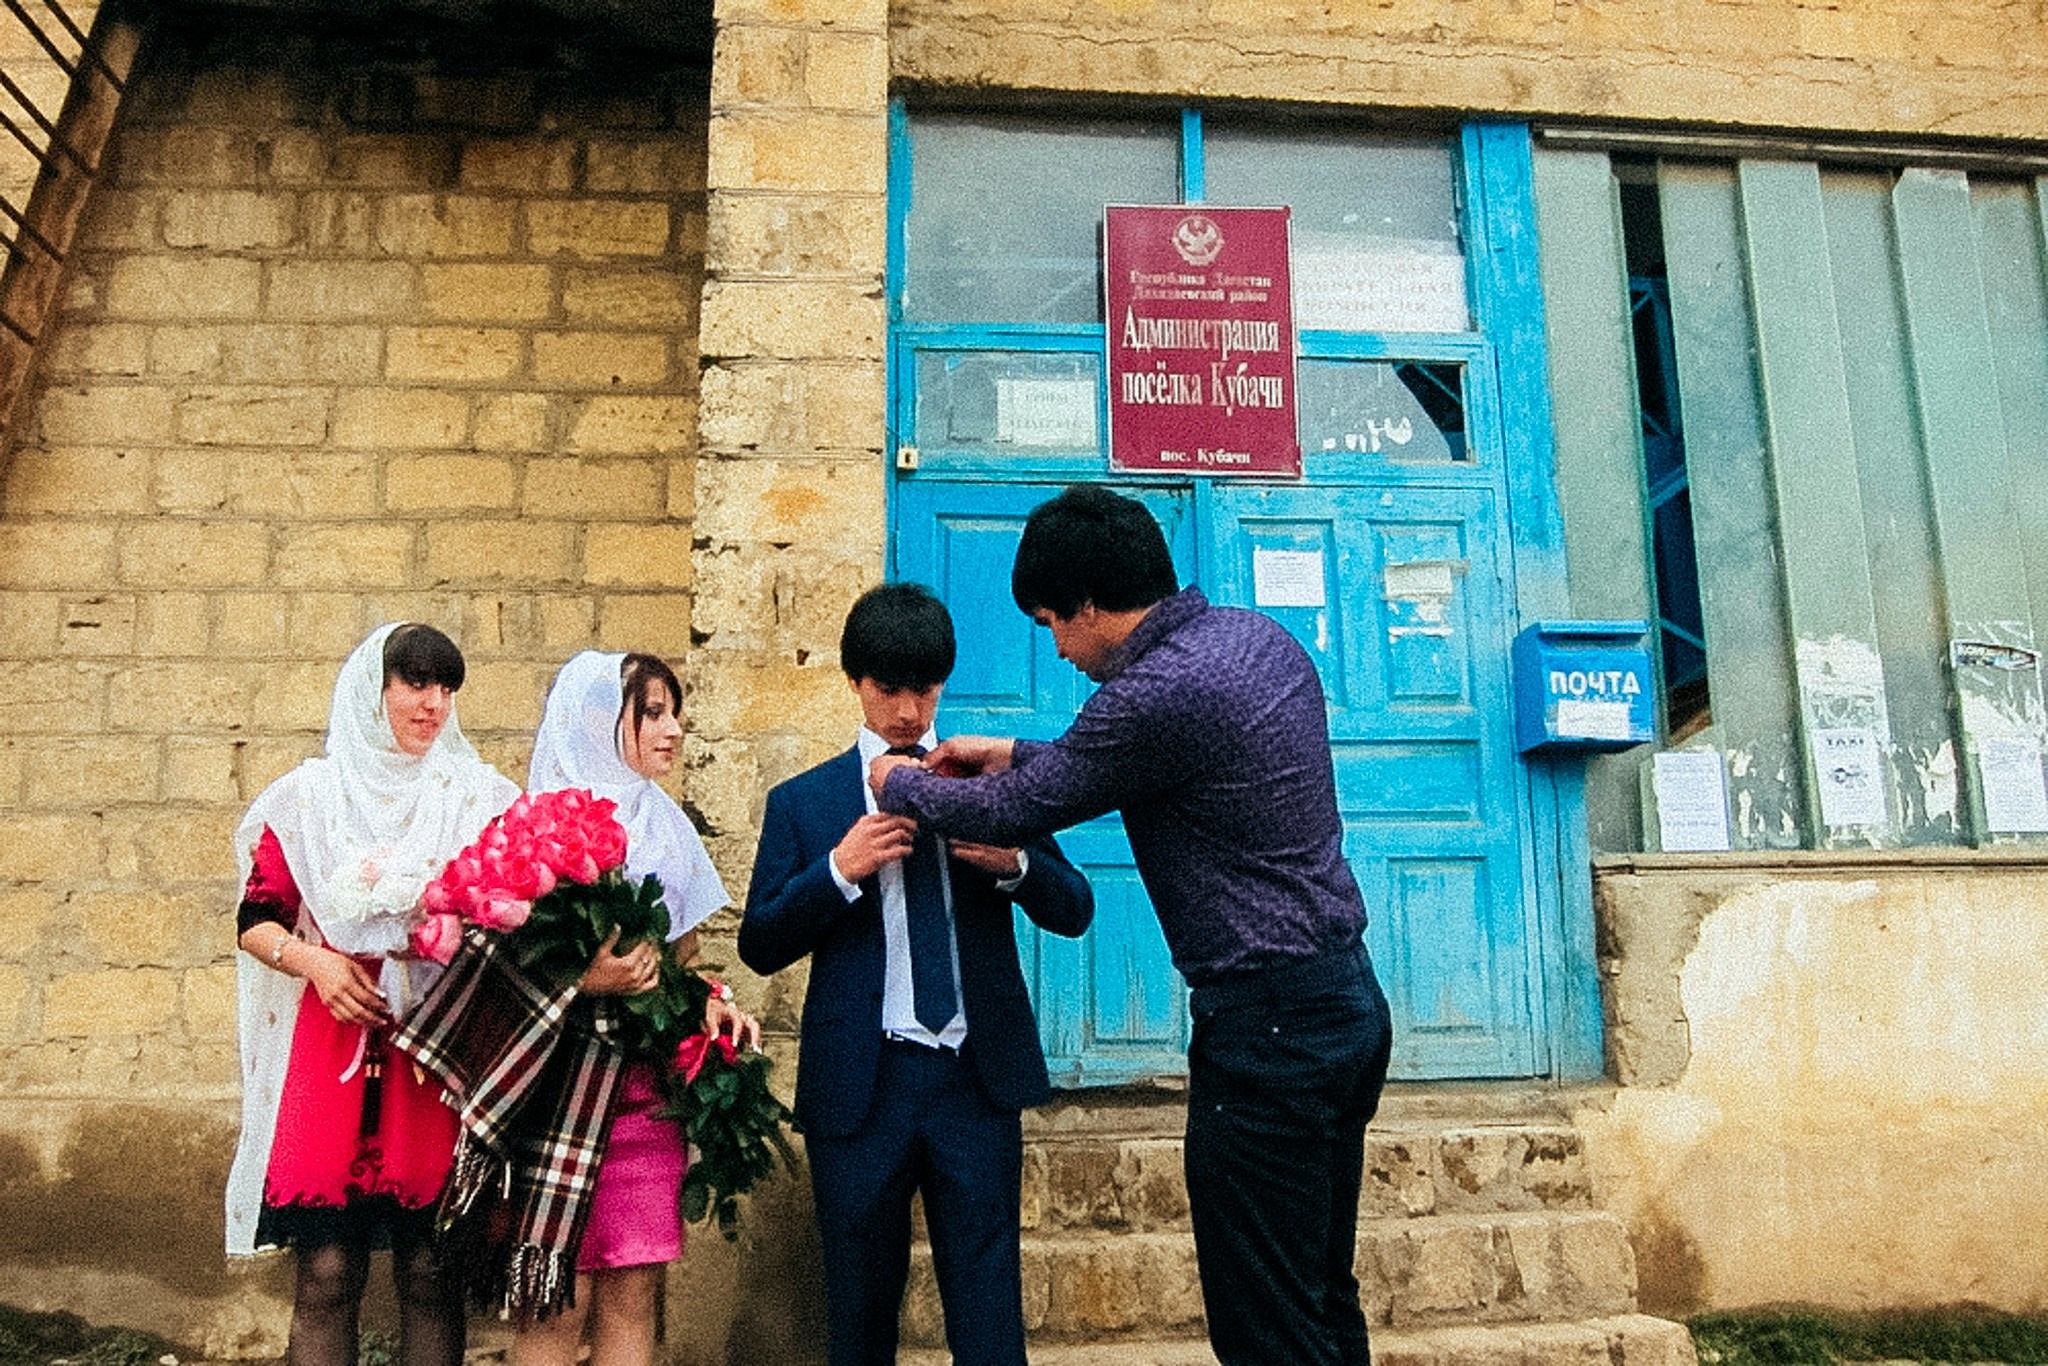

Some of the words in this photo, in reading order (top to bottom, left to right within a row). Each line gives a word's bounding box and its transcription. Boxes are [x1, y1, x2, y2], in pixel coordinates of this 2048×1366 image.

[1129, 270, 1206, 286] Республика
[1229, 290, 1268, 304] район
[1121, 304, 1280, 361] Администрация
[1121, 360, 1203, 406] посёлка
[1210, 362, 1285, 417] Кубачи
[1160, 451, 1191, 464] пос.
[1197, 449, 1252, 465] Кубачи
[1550, 670, 1641, 695] ПОЧТА
